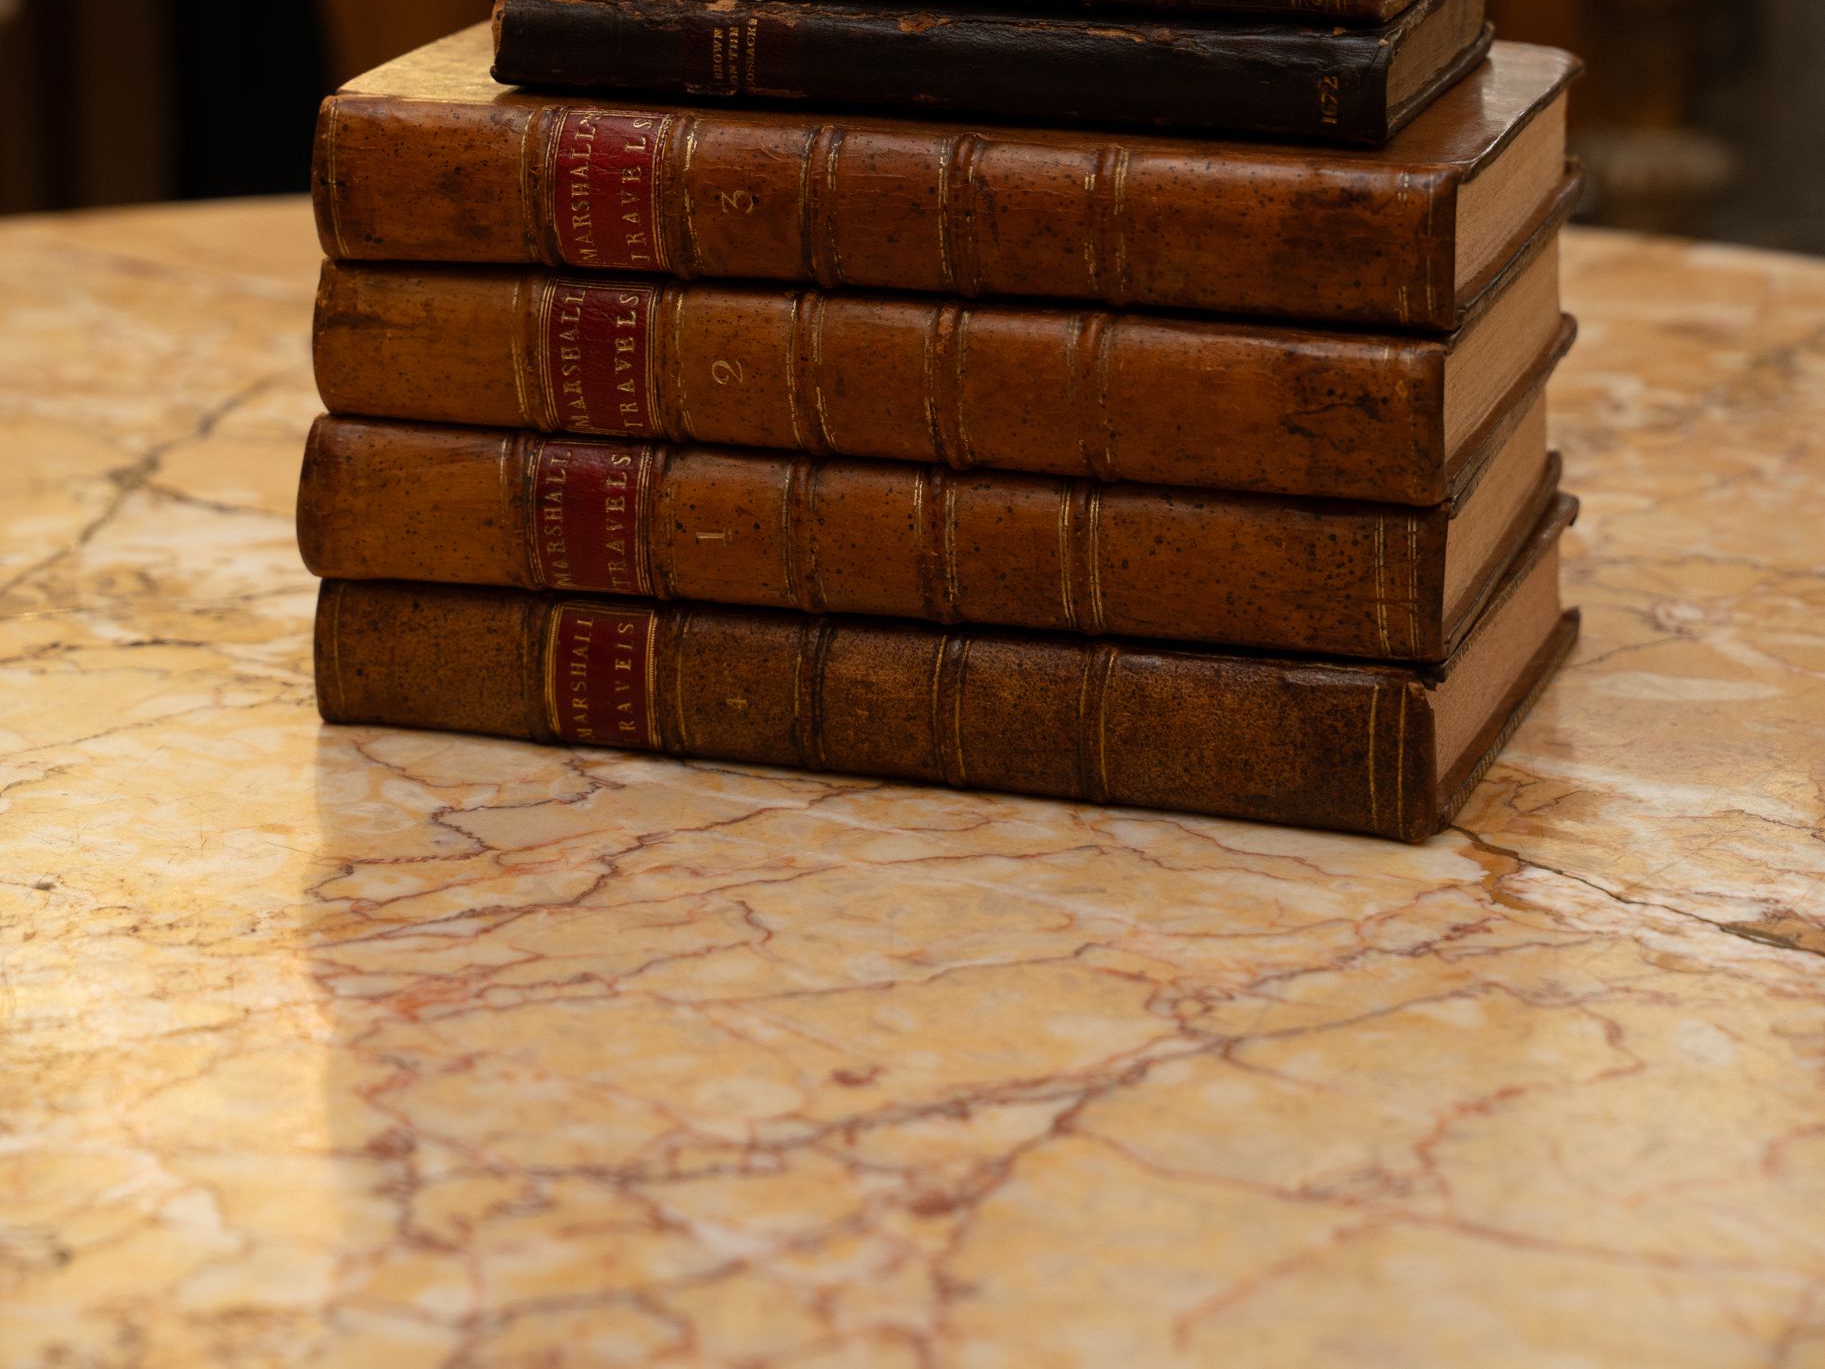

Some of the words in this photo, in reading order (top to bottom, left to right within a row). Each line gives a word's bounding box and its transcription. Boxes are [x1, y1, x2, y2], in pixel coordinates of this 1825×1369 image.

[620, 118, 652, 268] TRAVELS
[720, 189, 754, 214] 3
[560, 289, 590, 430] MARSHALL
[614, 293, 644, 429] TRAVELS
[711, 359, 744, 386] 2
[544, 449, 573, 587] MARSHALL
[605, 452, 633, 589] TRAVELS
